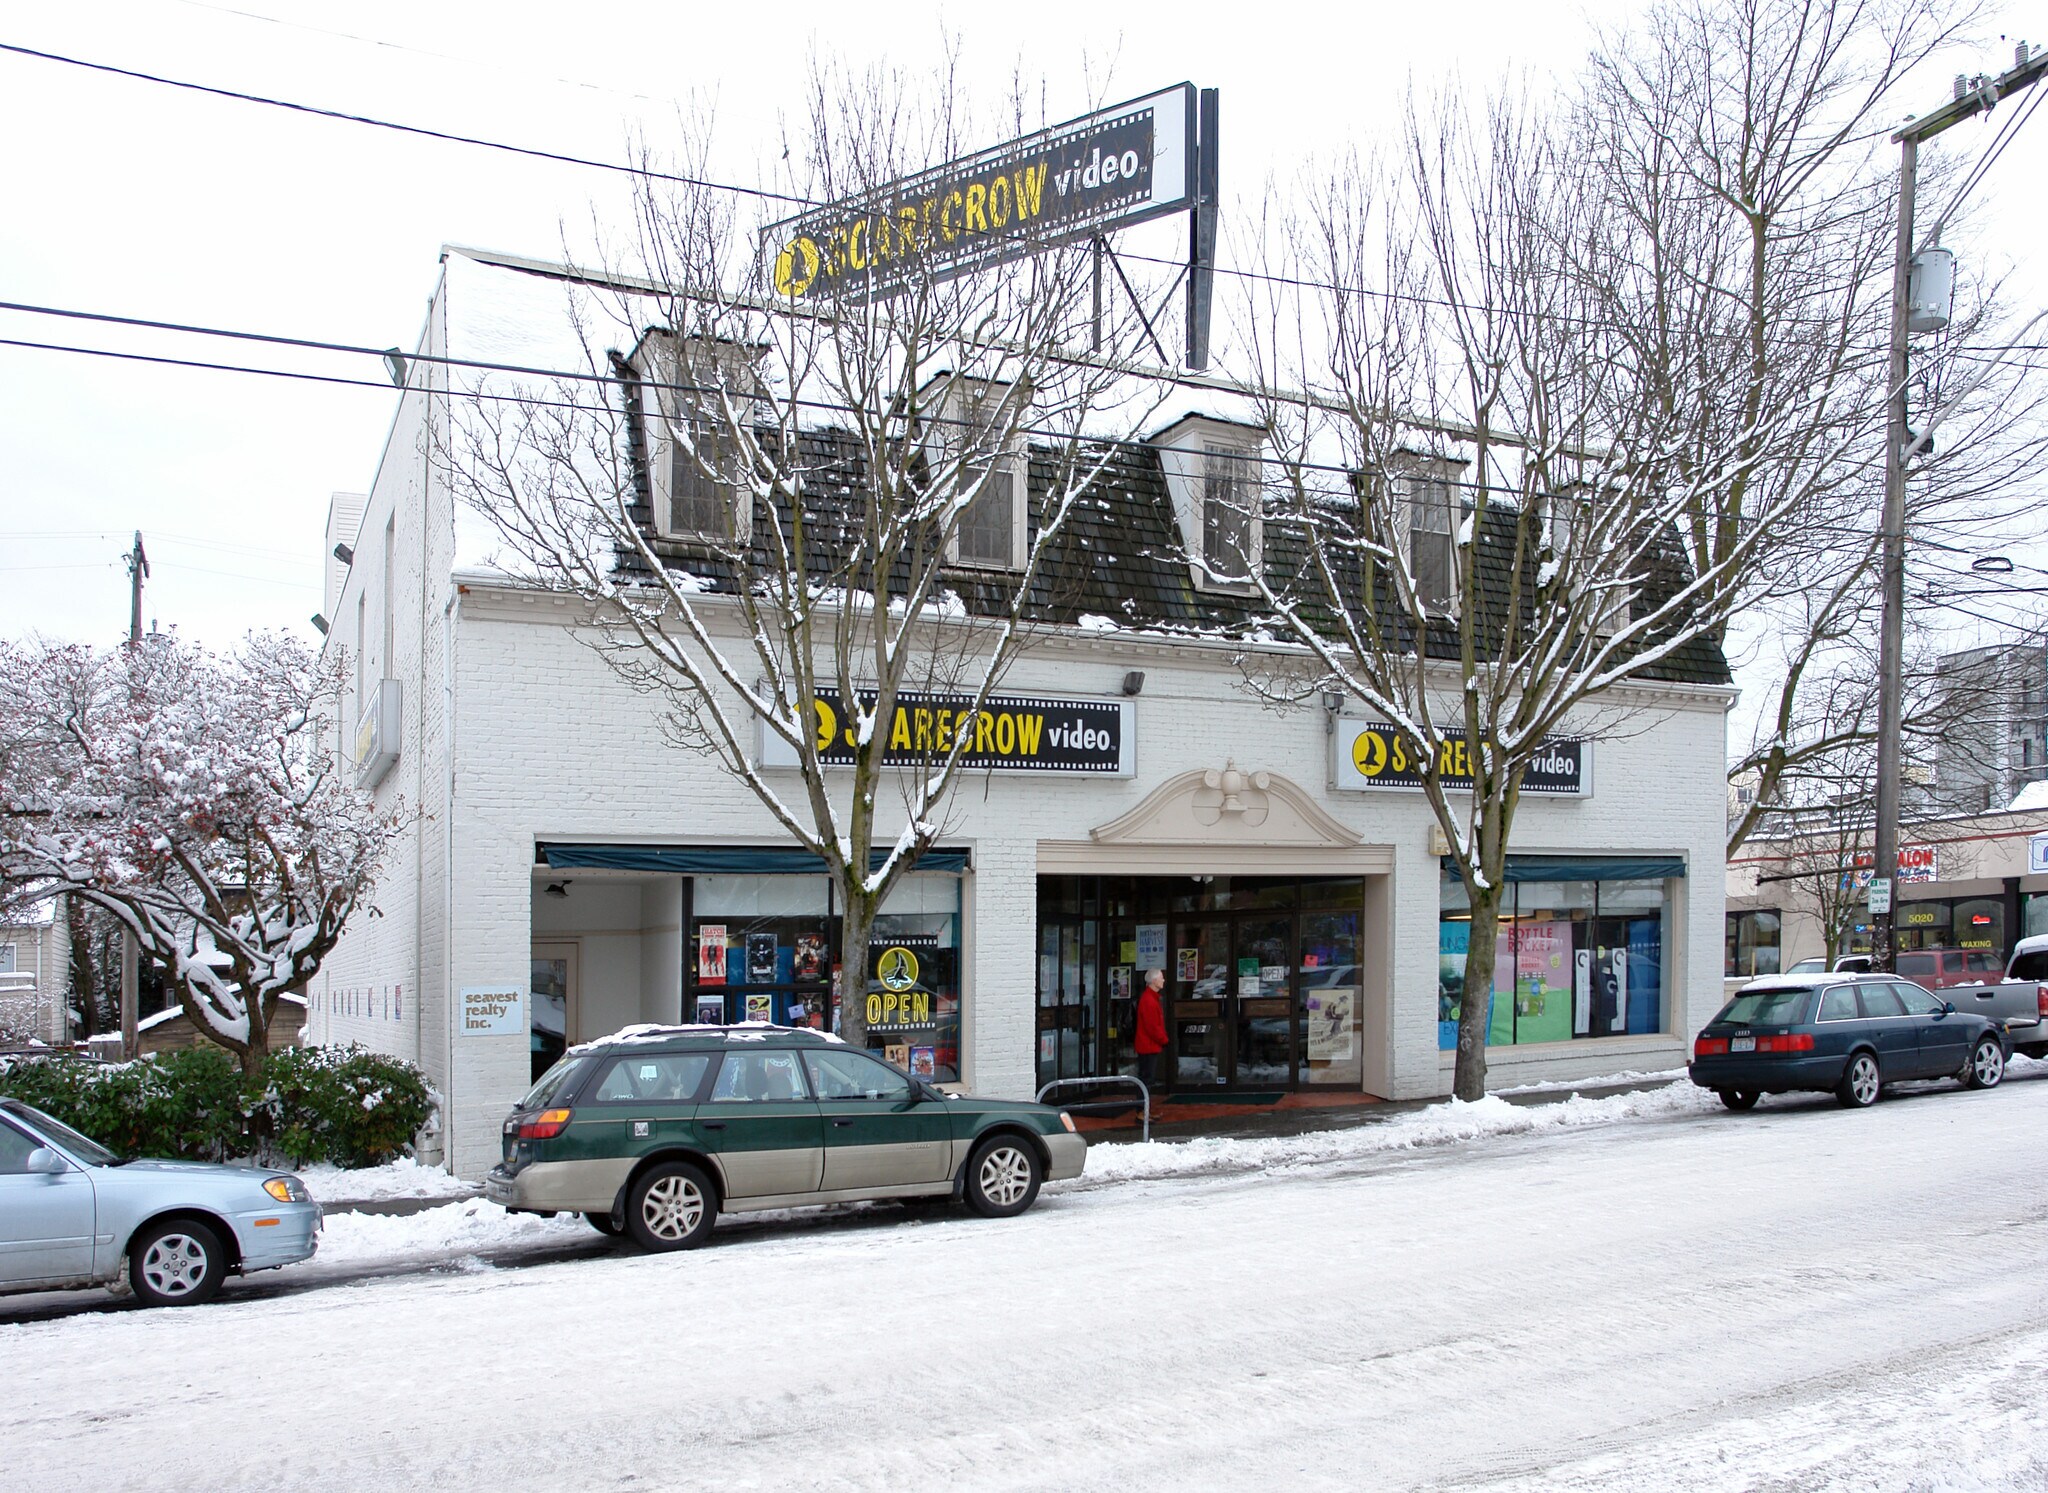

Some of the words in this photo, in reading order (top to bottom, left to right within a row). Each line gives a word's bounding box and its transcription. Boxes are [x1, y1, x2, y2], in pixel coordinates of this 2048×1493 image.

[1054, 148, 1139, 197] video
[844, 704, 1044, 756] ARECROW
[1048, 719, 1110, 751] video
[1532, 749, 1574, 776] video
[1897, 849, 1934, 867] ALON
[1908, 913, 1934, 923] 5020
[1508, 928, 1553, 940] BOTTLE
[1508, 940, 1552, 953] ROCKET
[1960, 940, 1992, 948] WAXING
[1264, 968, 1283, 980] OPEN
[465, 991, 518, 1003] seavest
[465, 1003, 507, 1018] realty
[867, 993, 929, 1024] OPEN
[465, 1017, 492, 1029] inc.
